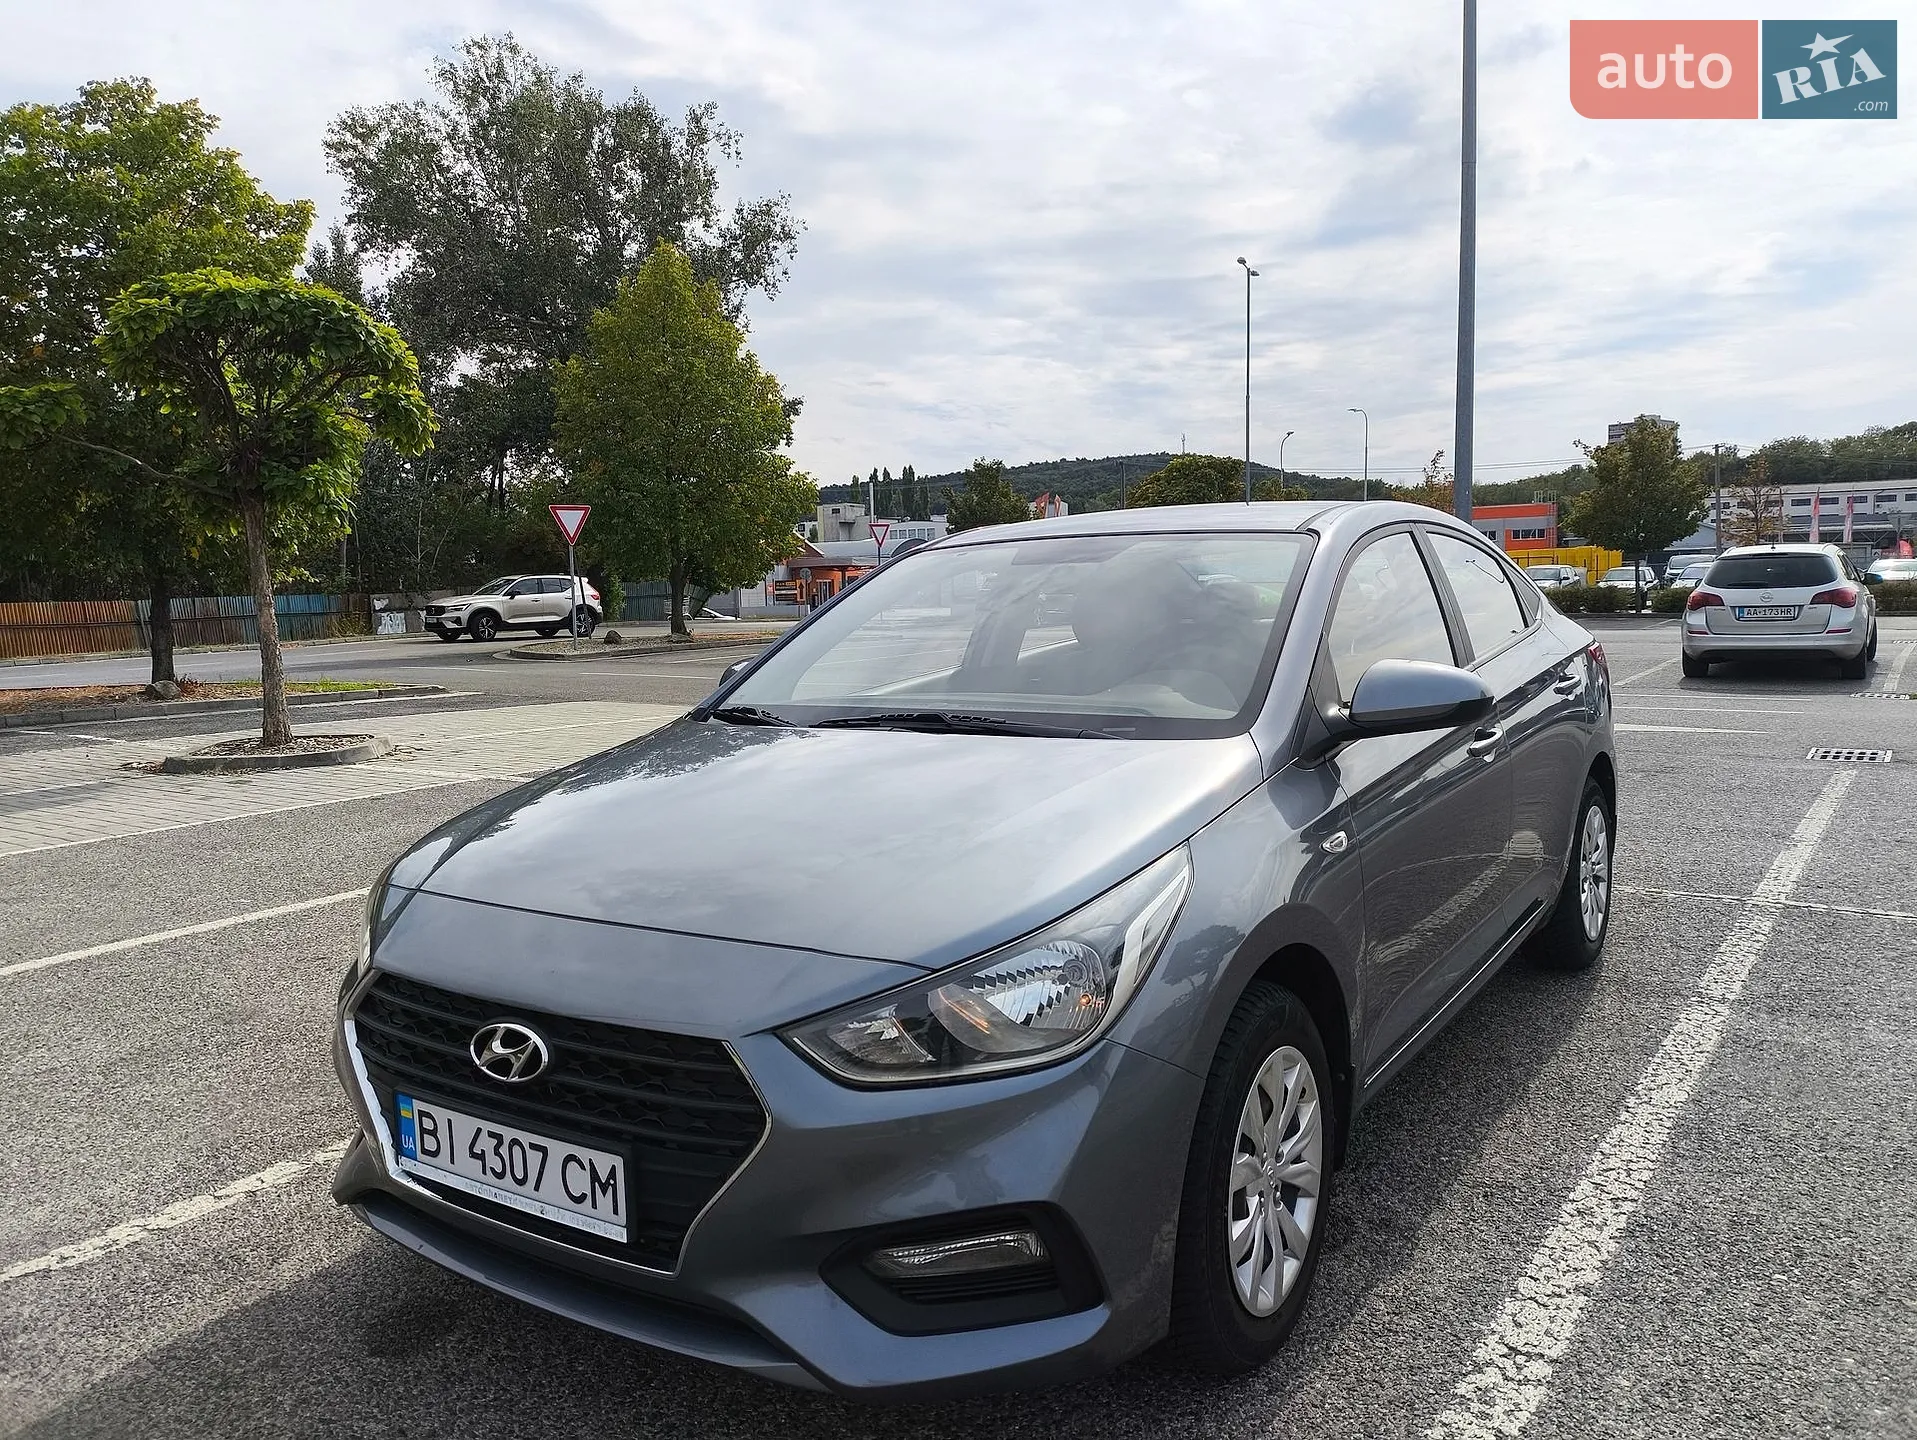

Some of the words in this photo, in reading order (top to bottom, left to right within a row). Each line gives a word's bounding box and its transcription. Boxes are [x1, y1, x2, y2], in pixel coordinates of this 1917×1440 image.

[402, 1137, 415, 1151] UA
[418, 1109, 454, 1165] BI
[469, 1127, 548, 1191] 4307
[561, 1154, 619, 1215] CM
